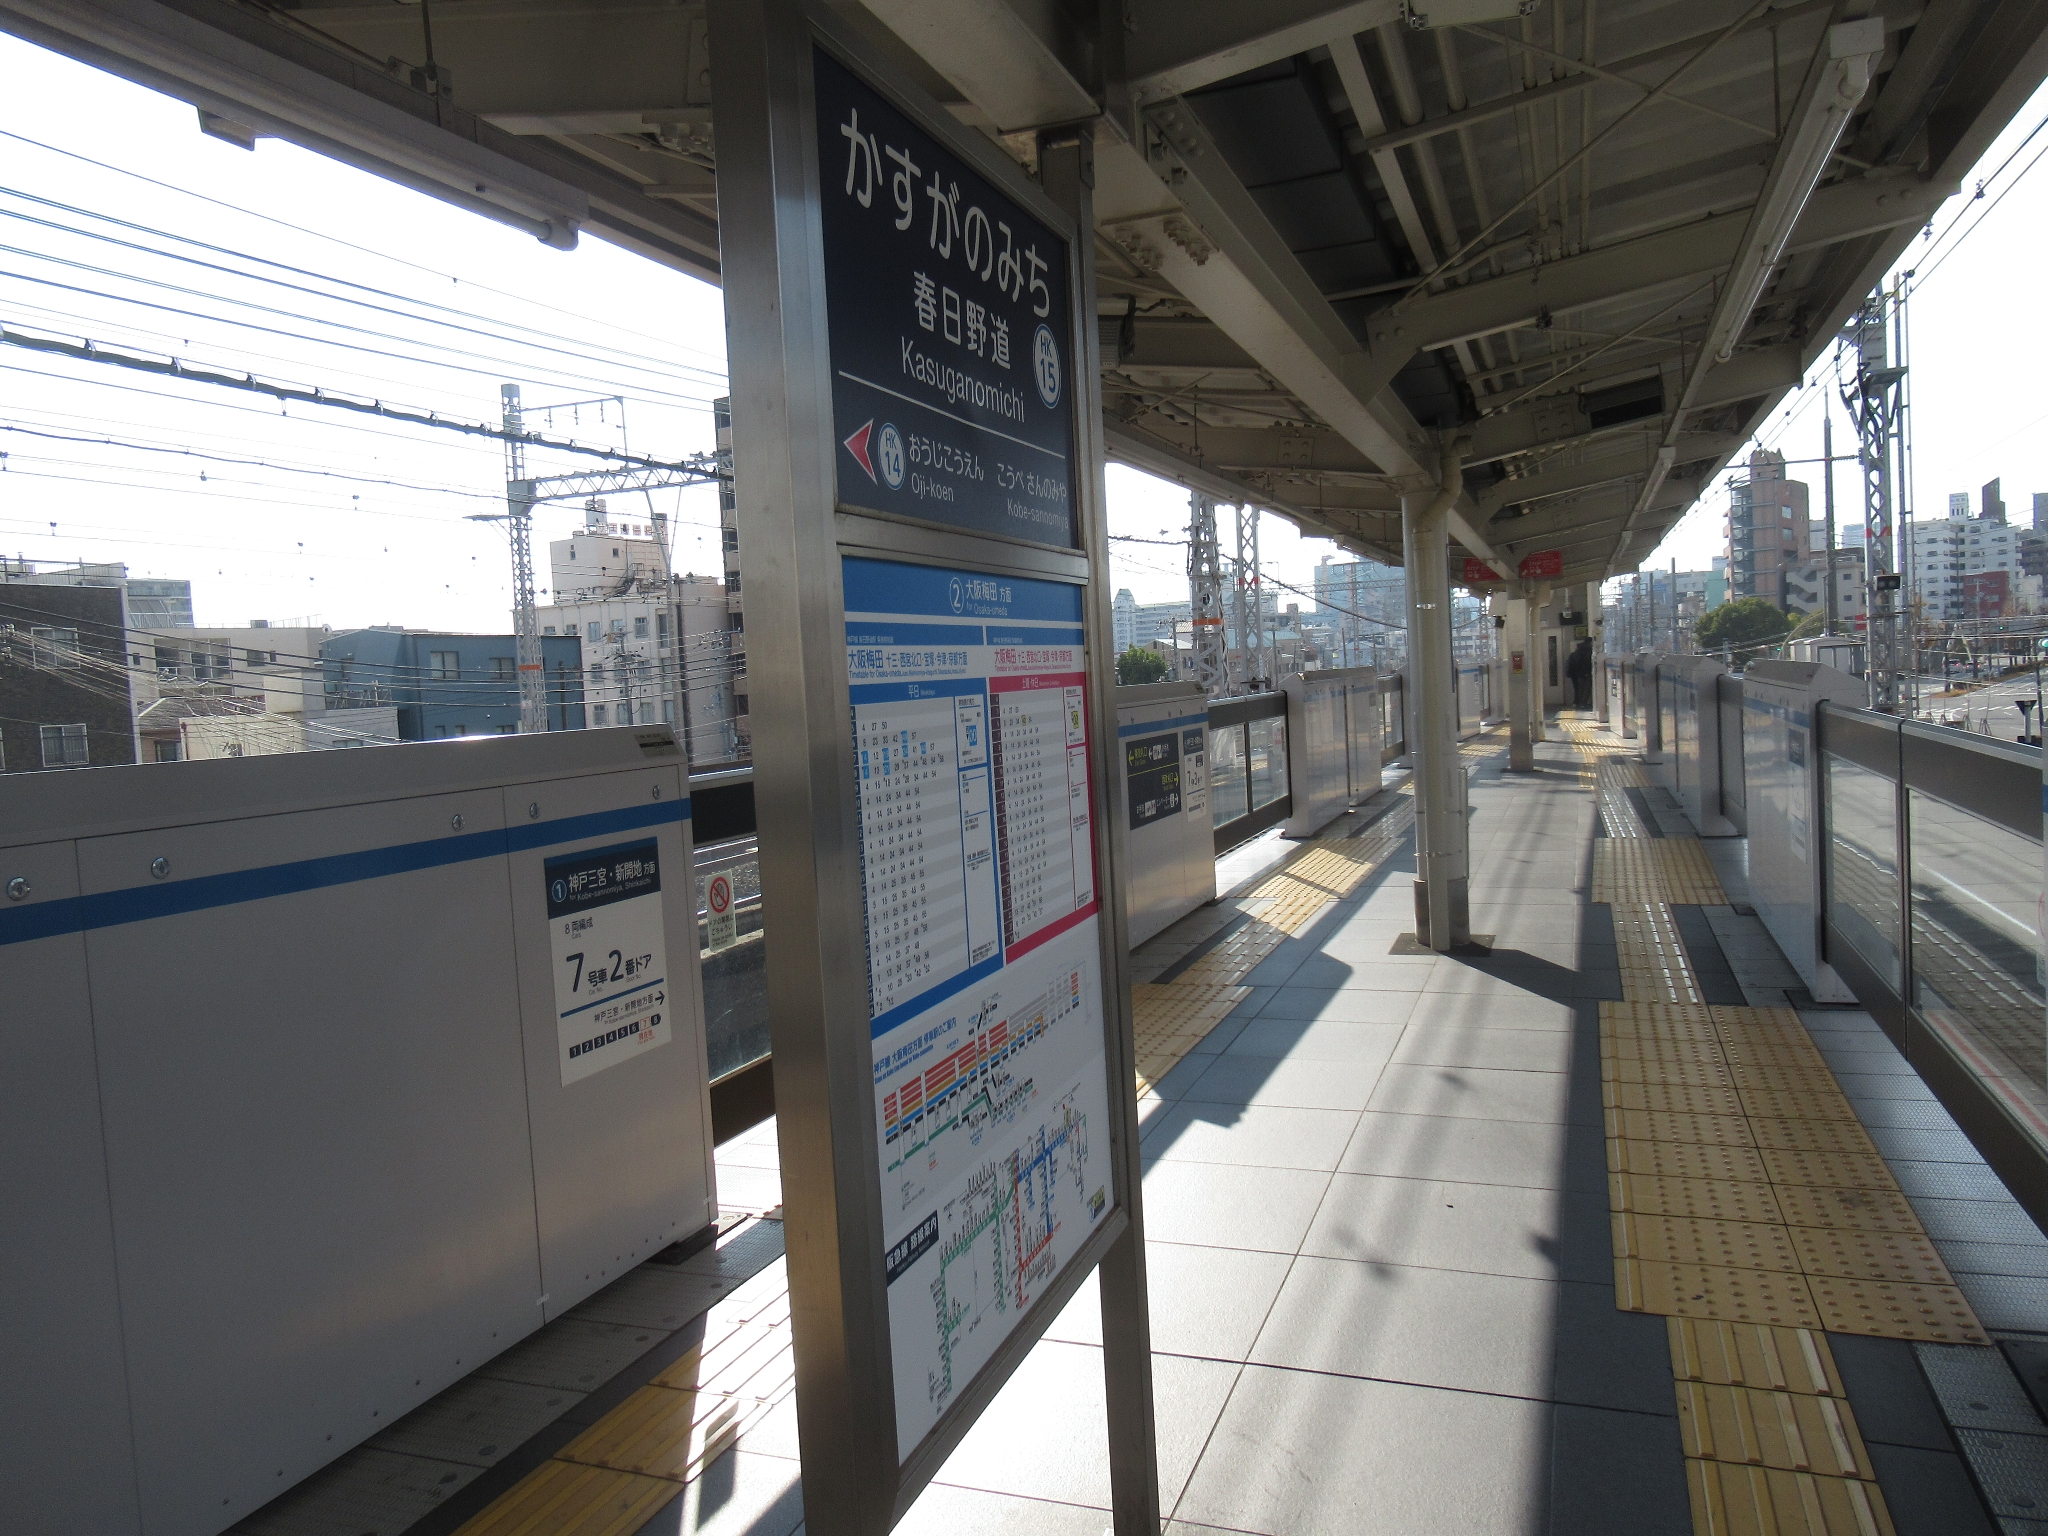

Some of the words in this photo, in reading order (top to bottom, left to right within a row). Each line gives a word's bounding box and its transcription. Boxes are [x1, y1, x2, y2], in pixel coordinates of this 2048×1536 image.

[840, 107, 1050, 318] かすがのみち
[913, 271, 1011, 370] 春日野道
[1039, 334, 1053, 358] HK
[901, 335, 1025, 423] Kasuganomichi
[1039, 357, 1057, 395] 15
[885, 431, 898, 450] HK
[909, 433, 984, 482] おうじこうえん
[885, 450, 901, 478] 14
[911, 472, 954, 502] Oji-koen
[1007, 498, 1070, 532] Kobe-sannomiya
[965, 579, 997, 601] 大阪梅田
[999, 586, 1012, 603] 方面
[848, 649, 884, 669] 大阪梅田
[585, 1042, 590, 1051] 2
[597, 1038, 602, 1047] 3
[608, 1033, 614, 1042] 4
[620, 1028, 626, 1037] 5
[631, 1024, 637, 1033] 6
[653, 1016, 658, 1024] 8
